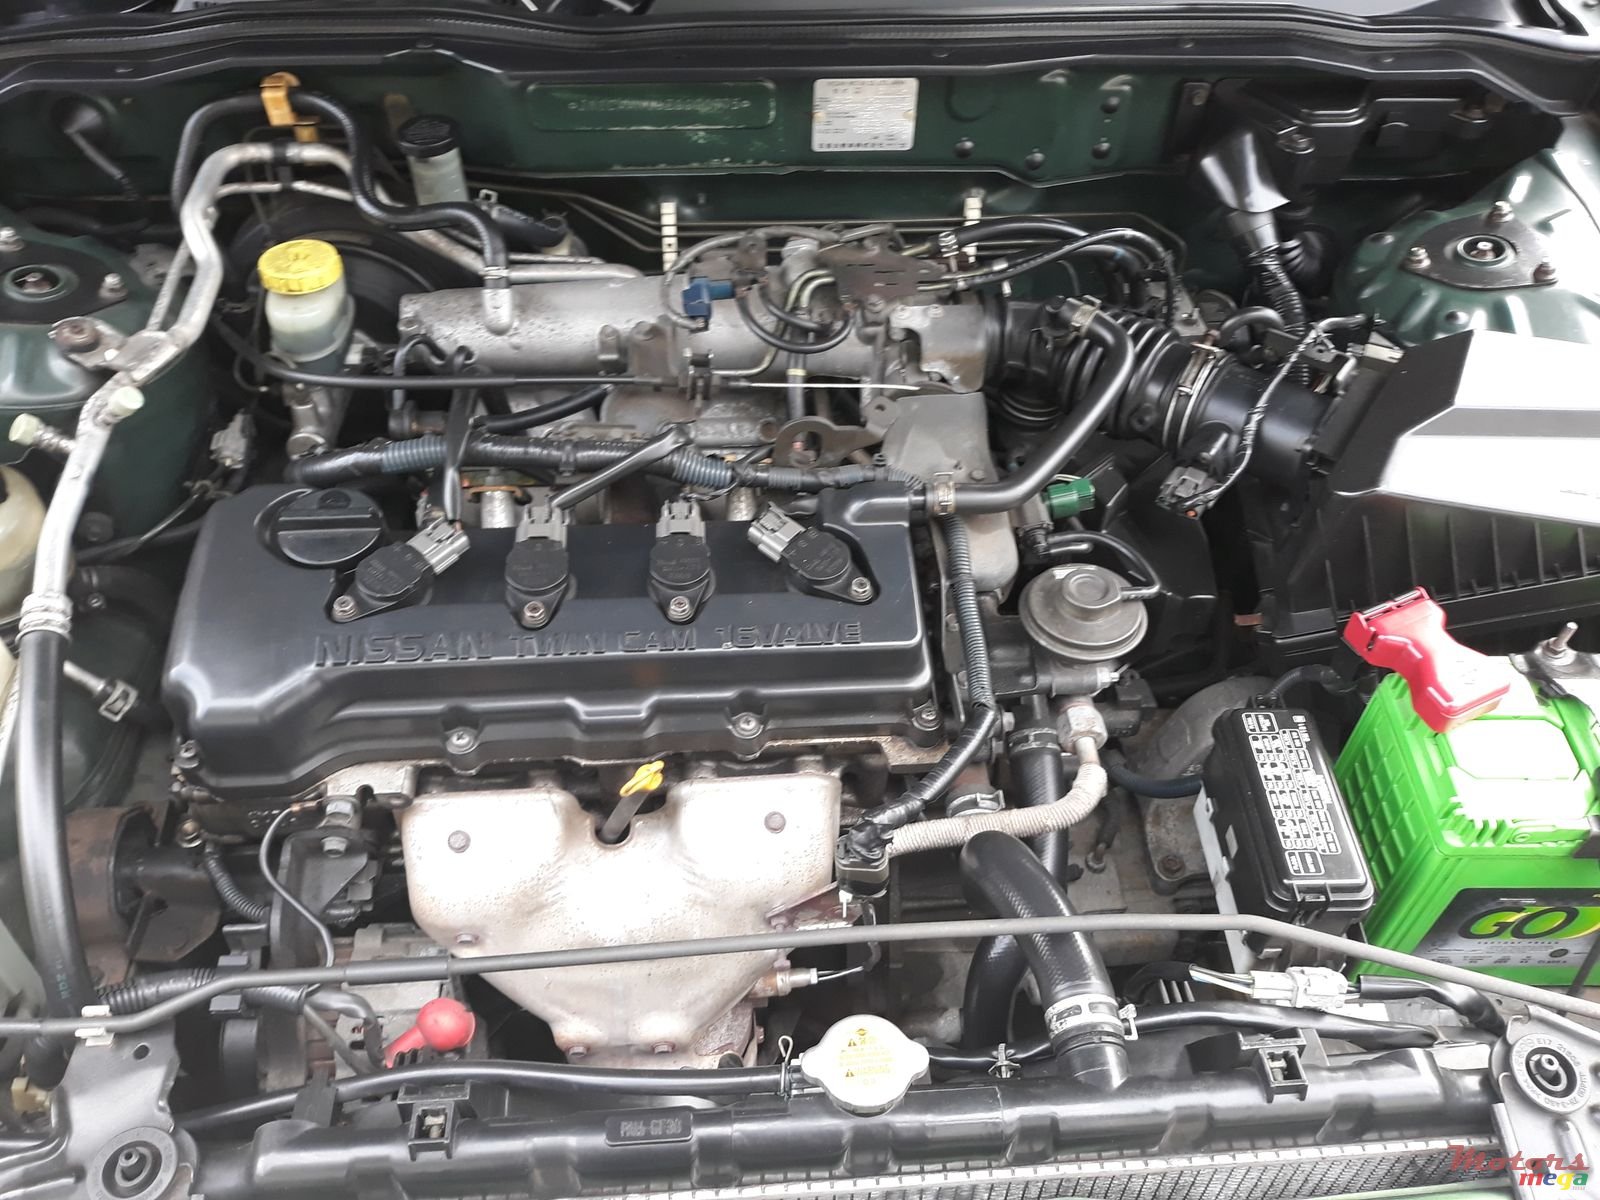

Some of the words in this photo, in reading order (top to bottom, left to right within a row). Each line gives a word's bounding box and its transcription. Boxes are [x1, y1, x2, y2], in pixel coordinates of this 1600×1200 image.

[315, 633, 492, 667] NISSAN
[509, 632, 606, 658] TWIN
[618, 627, 697, 653] CAM
[1458, 906, 1580, 940] GO
